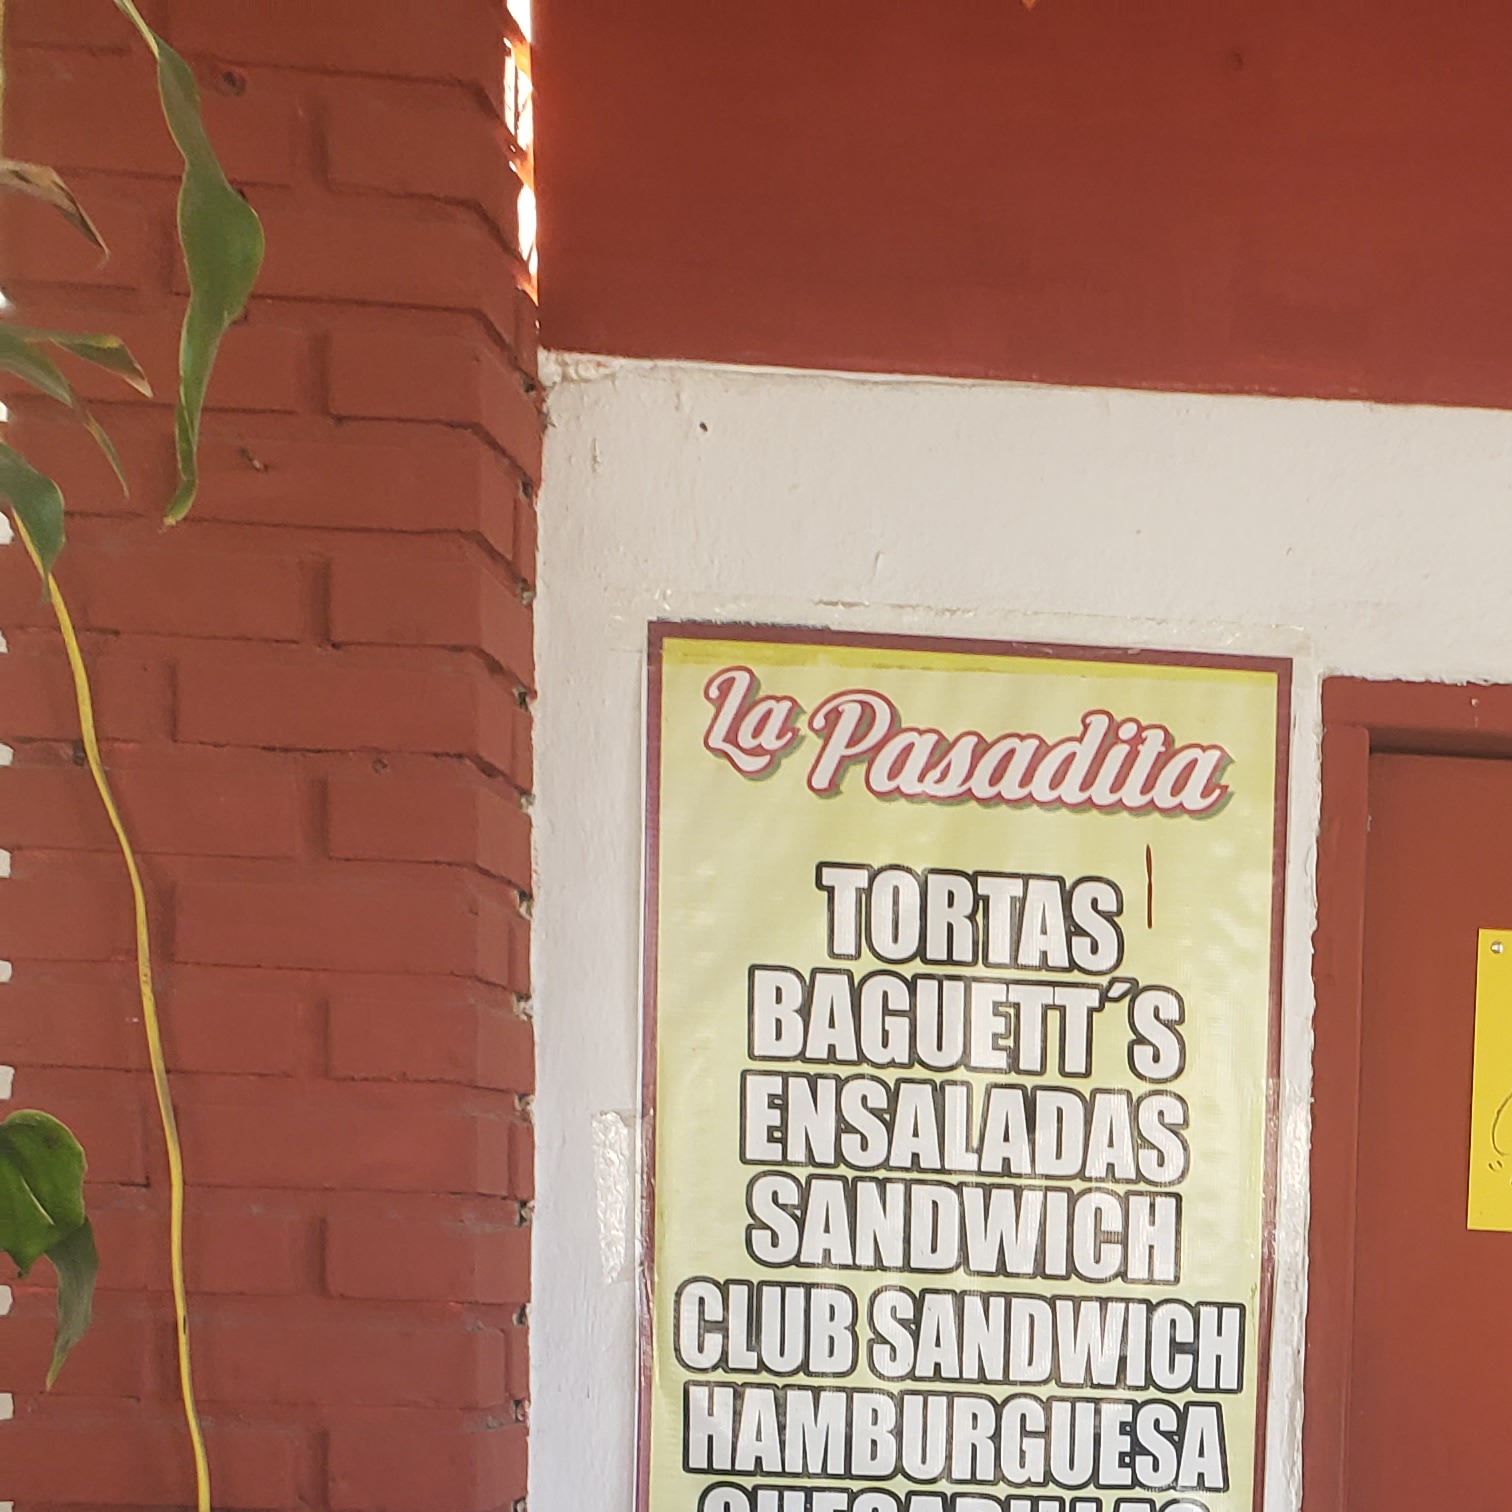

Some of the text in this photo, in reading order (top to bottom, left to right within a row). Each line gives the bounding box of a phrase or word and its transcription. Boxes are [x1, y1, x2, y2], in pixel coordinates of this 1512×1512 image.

[704, 665, 1232, 816] La Pasadita
[815, 862, 1122, 973] TORTAS
[739, 1069, 1190, 1186] ENSALADAS
[745, 1170, 1183, 1285] SANDWICH
[673, 1276, 1245, 1393] CLUB SANDWICH
[682, 1380, 1229, 1493] HAMBURGUESA
